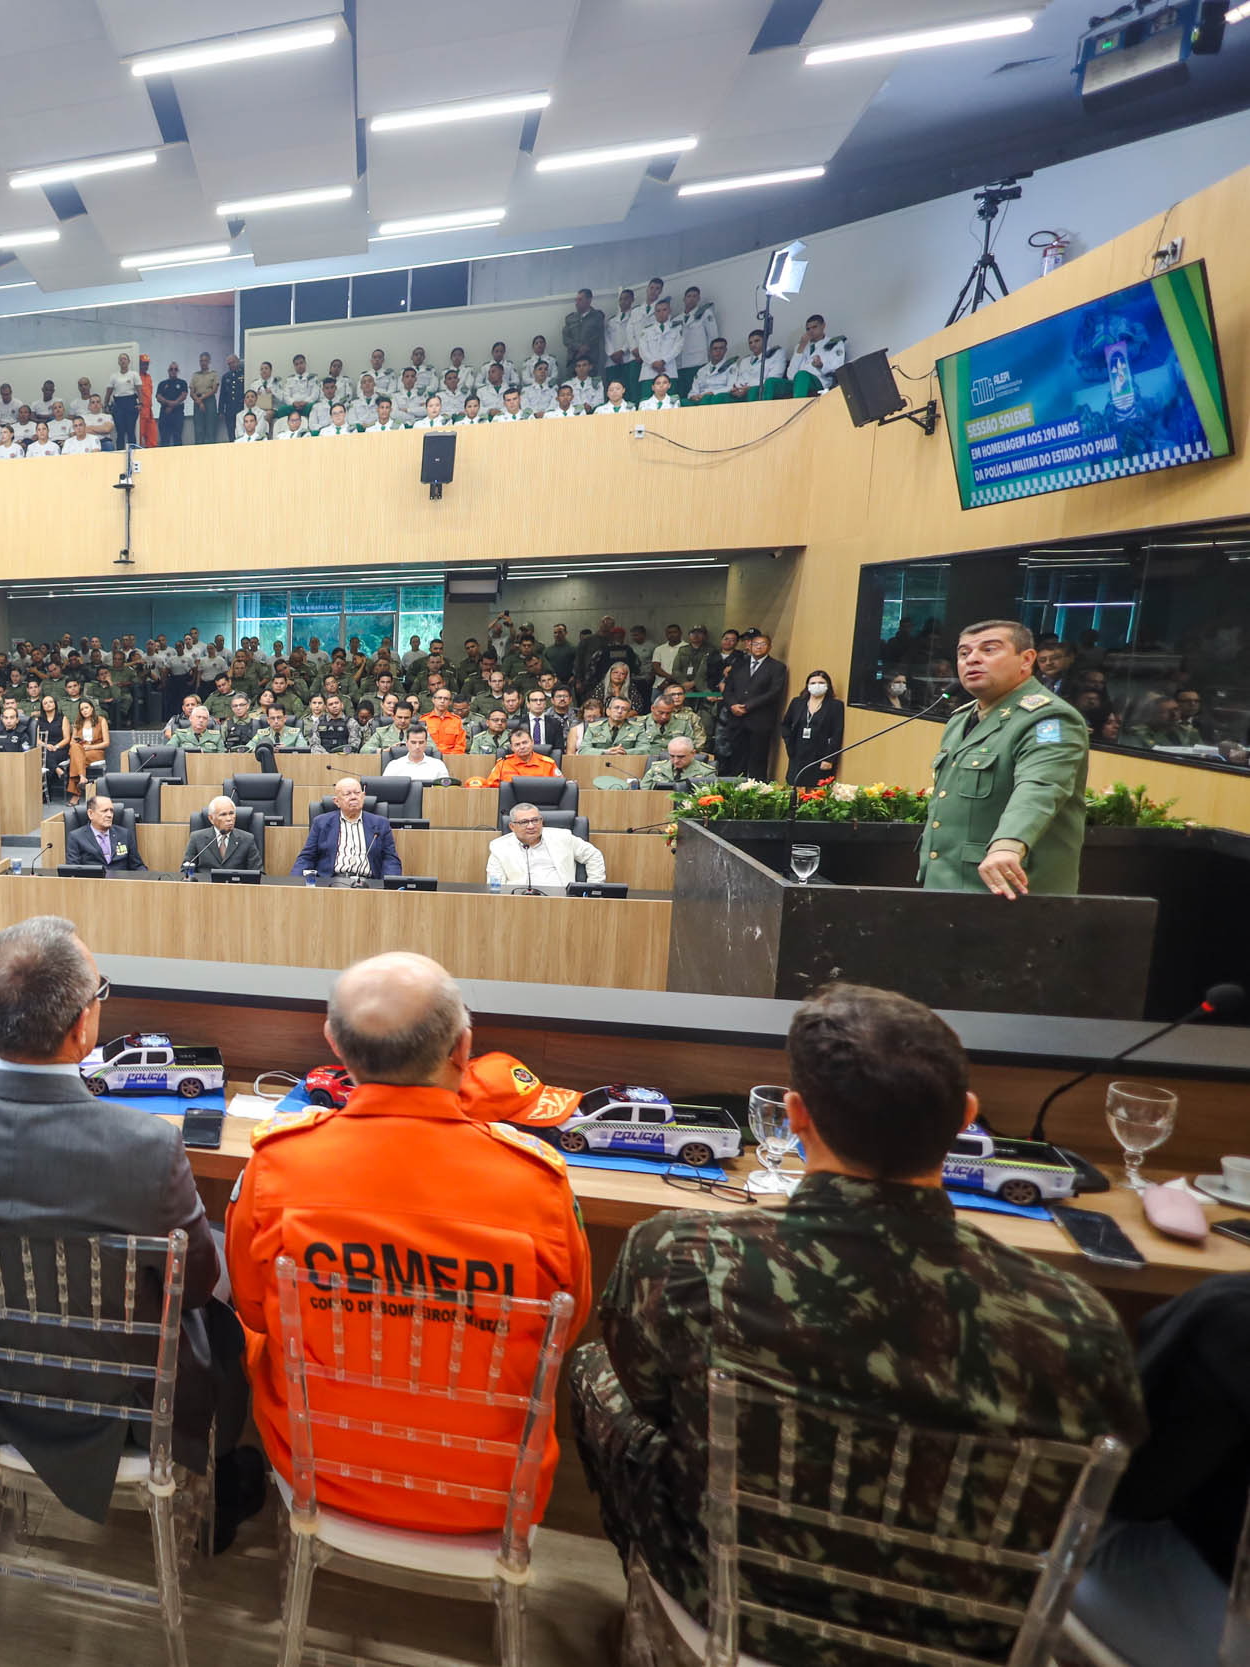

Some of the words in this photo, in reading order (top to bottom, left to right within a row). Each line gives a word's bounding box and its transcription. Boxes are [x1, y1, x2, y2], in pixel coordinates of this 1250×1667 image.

[967, 417, 998, 438] SESSÃO
[998, 407, 1032, 430] SOLENE
[971, 447, 981, 460] EM
[981, 437, 1027, 457] HOMENAGEM
[1027, 434, 1042, 448] AOS
[1043, 427, 1057, 442] 190
[1057, 421, 1080, 439] ANOS
[974, 469, 985, 482] DA
[984, 463, 1012, 479] POLÍCIA
[1011, 457, 1039, 474] MILITAR
[1039, 454, 1051, 467] DO
[1051, 446, 1082, 464] ESTADO
[1082, 443, 1094, 458] DO
[1095, 434, 1118, 453] PIAUÍ
[304, 1242, 514, 1310] CBMEPI
